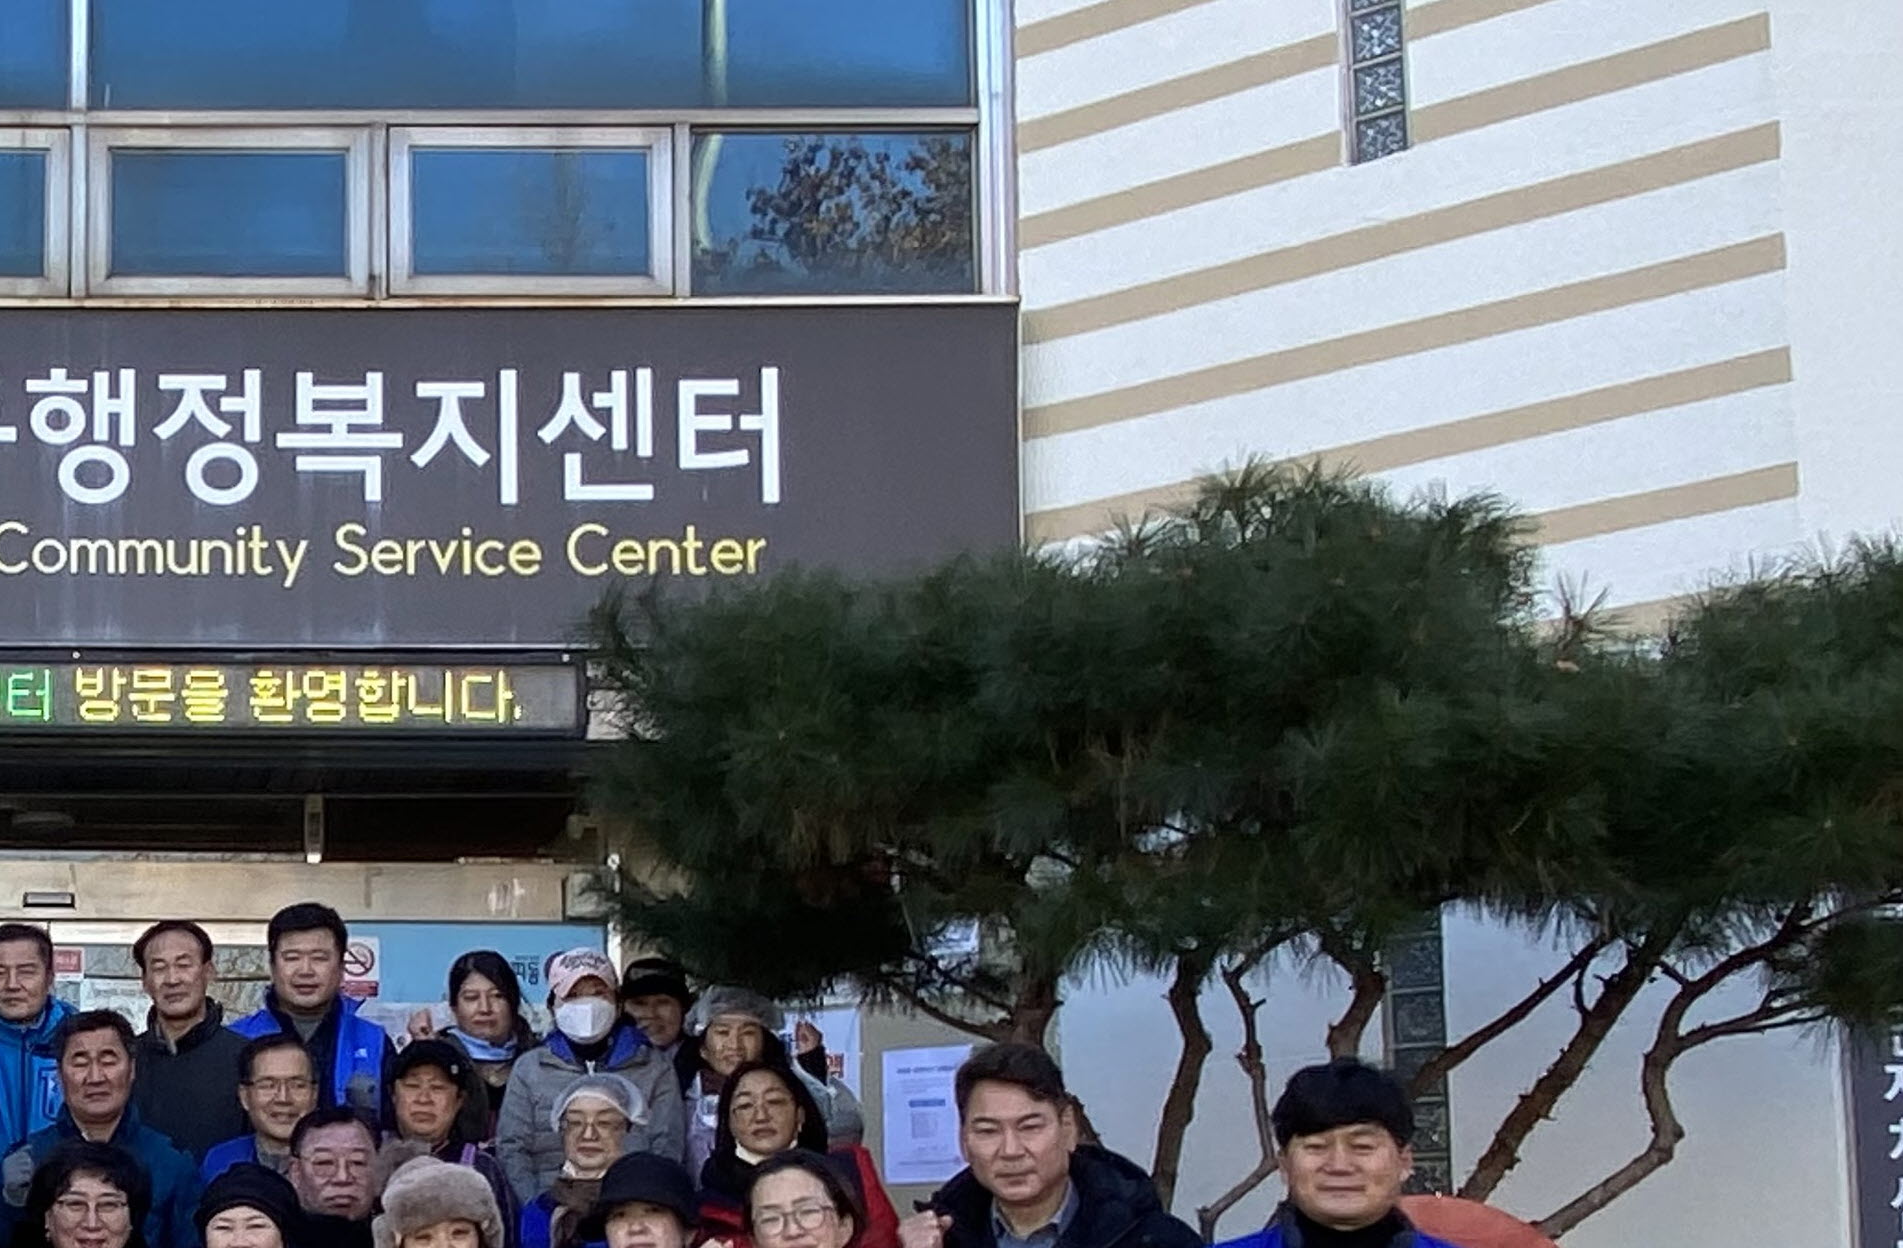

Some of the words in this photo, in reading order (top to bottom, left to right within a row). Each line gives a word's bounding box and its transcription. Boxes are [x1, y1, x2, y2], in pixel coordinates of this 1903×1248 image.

[332, 522, 543, 576] Service
[566, 522, 768, 577] Center
[75, 665, 228, 722] 방문을
[249, 666, 523, 723] 환영합니다.
